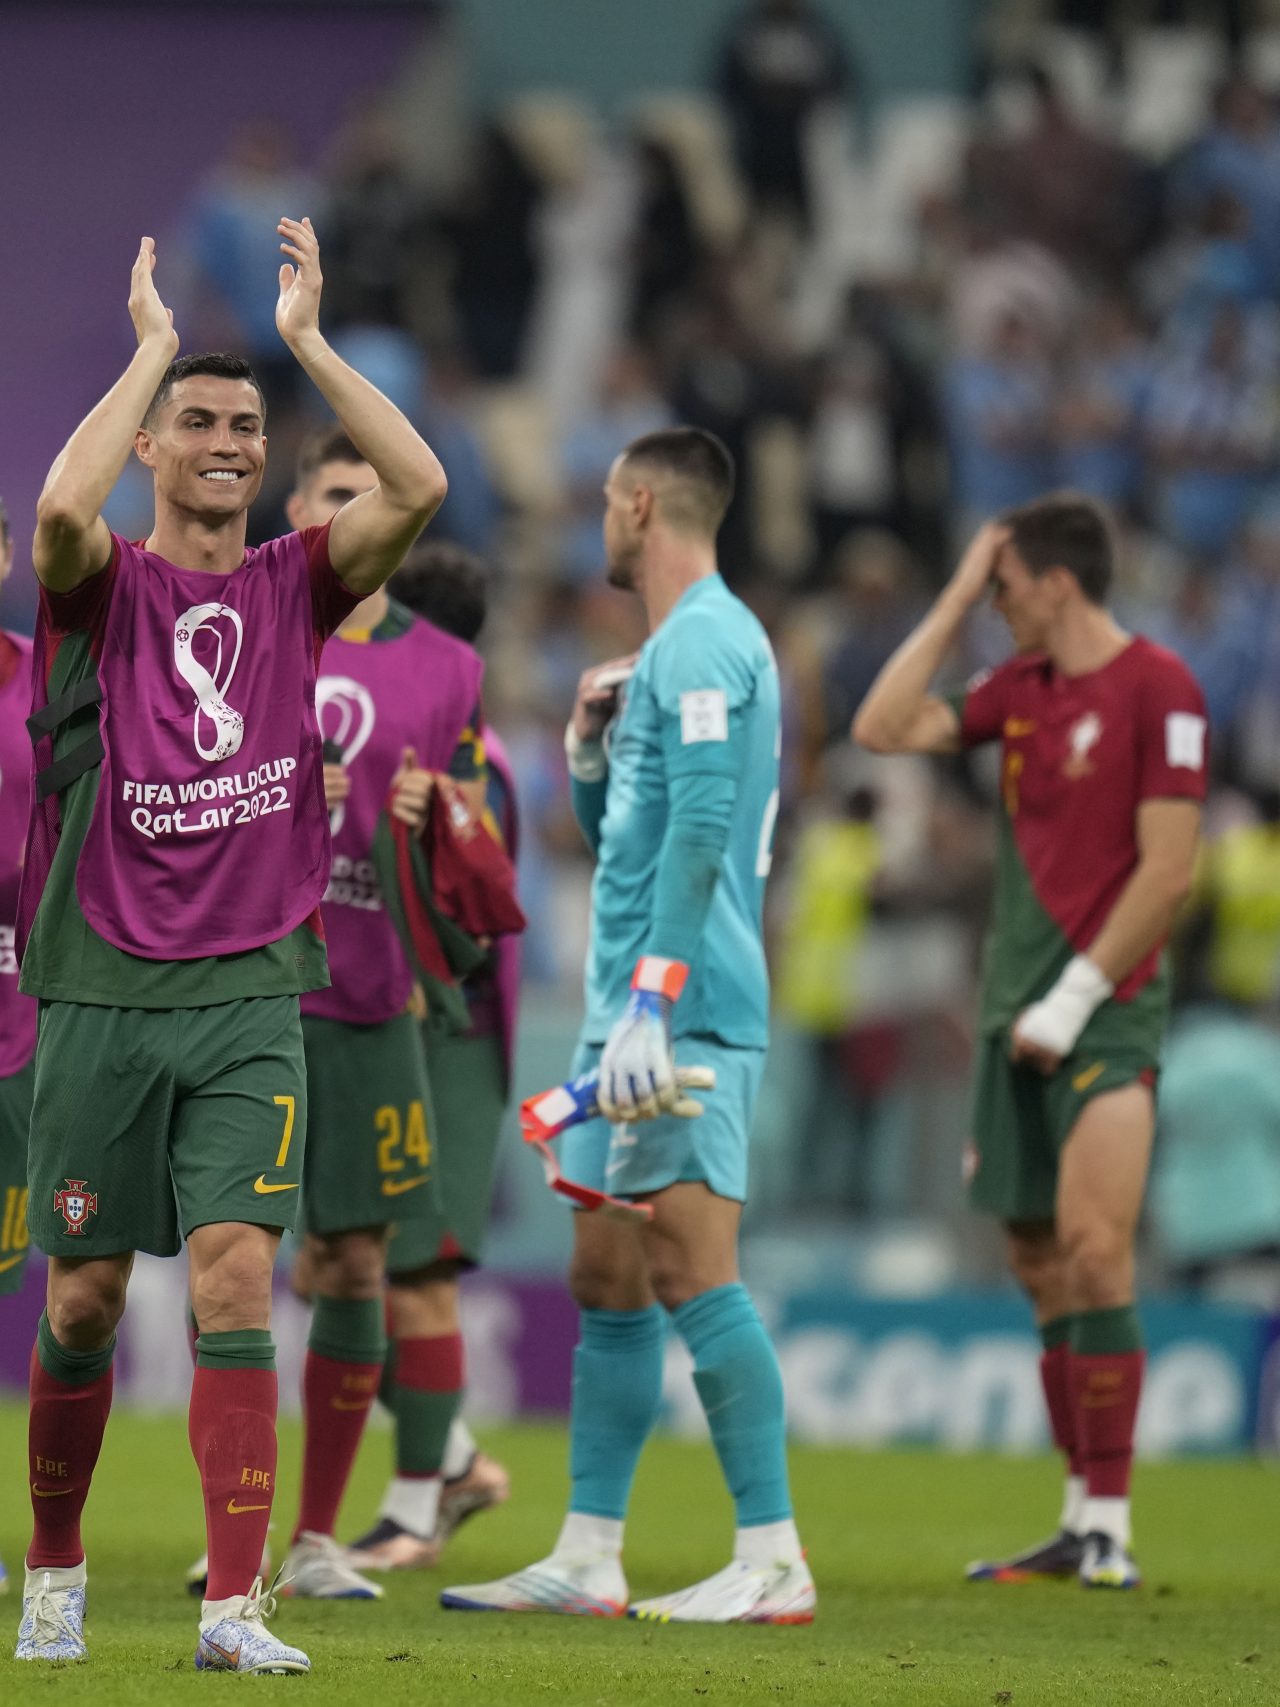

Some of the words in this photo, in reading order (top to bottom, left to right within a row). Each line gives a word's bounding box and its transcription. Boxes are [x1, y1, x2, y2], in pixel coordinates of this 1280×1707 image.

[122, 780, 176, 805] FIFA
[178, 770, 257, 804] WORLD
[257, 756, 297, 786] CUP
[273, 1095, 296, 1168] 7
[374, 1099, 433, 1173] 24
